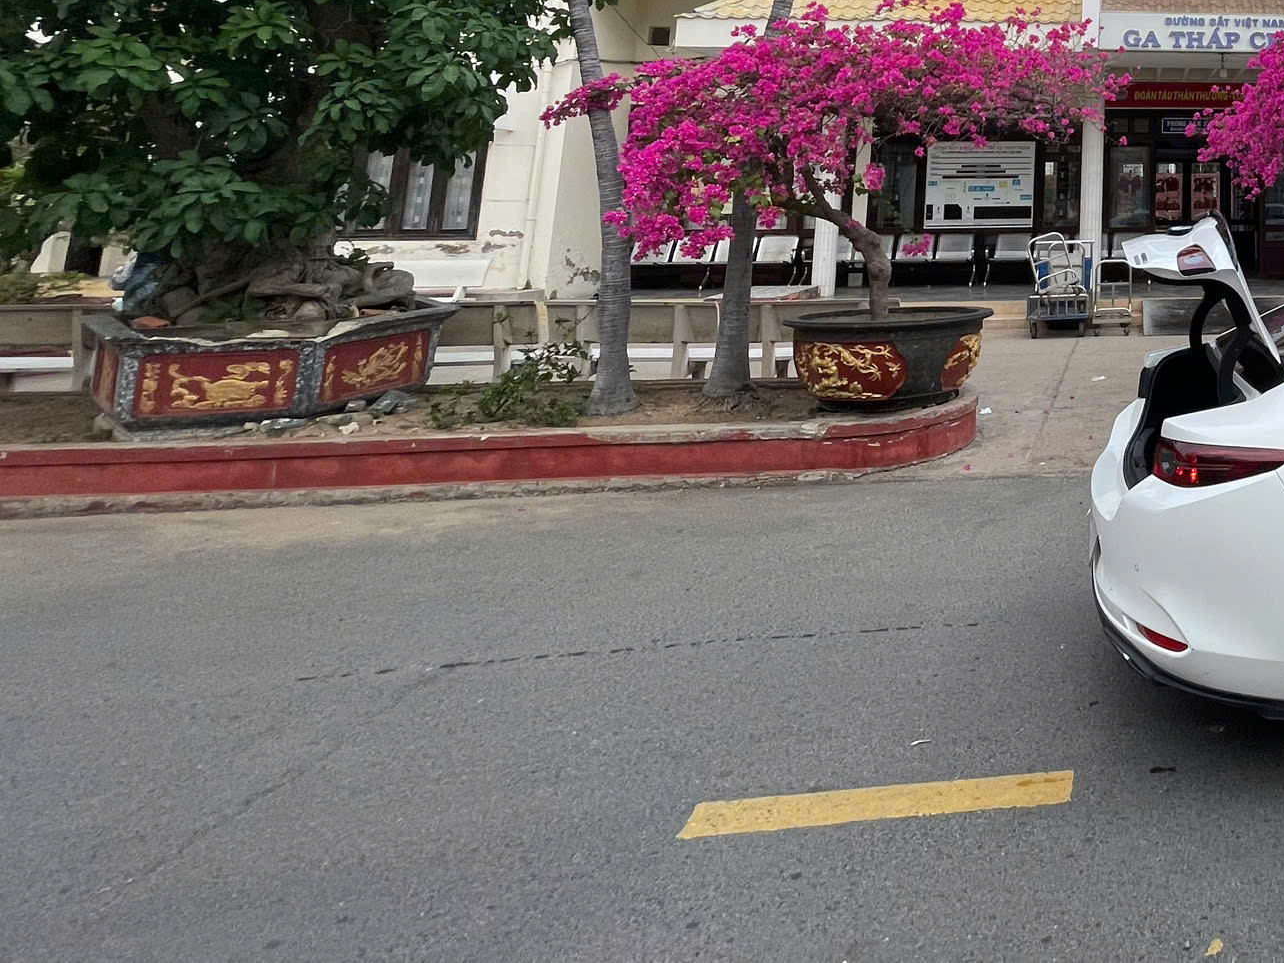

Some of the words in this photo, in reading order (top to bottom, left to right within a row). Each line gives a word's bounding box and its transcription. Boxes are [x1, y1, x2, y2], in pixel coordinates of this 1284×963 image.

[1165, 15, 1205, 27] ĐƯỜNG
[1209, 15, 1230, 27] SẮT
[1234, 17, 1258, 29] VIỆT
[1123, 30, 1162, 49] GA
[1168, 26, 1241, 49] THÁP
